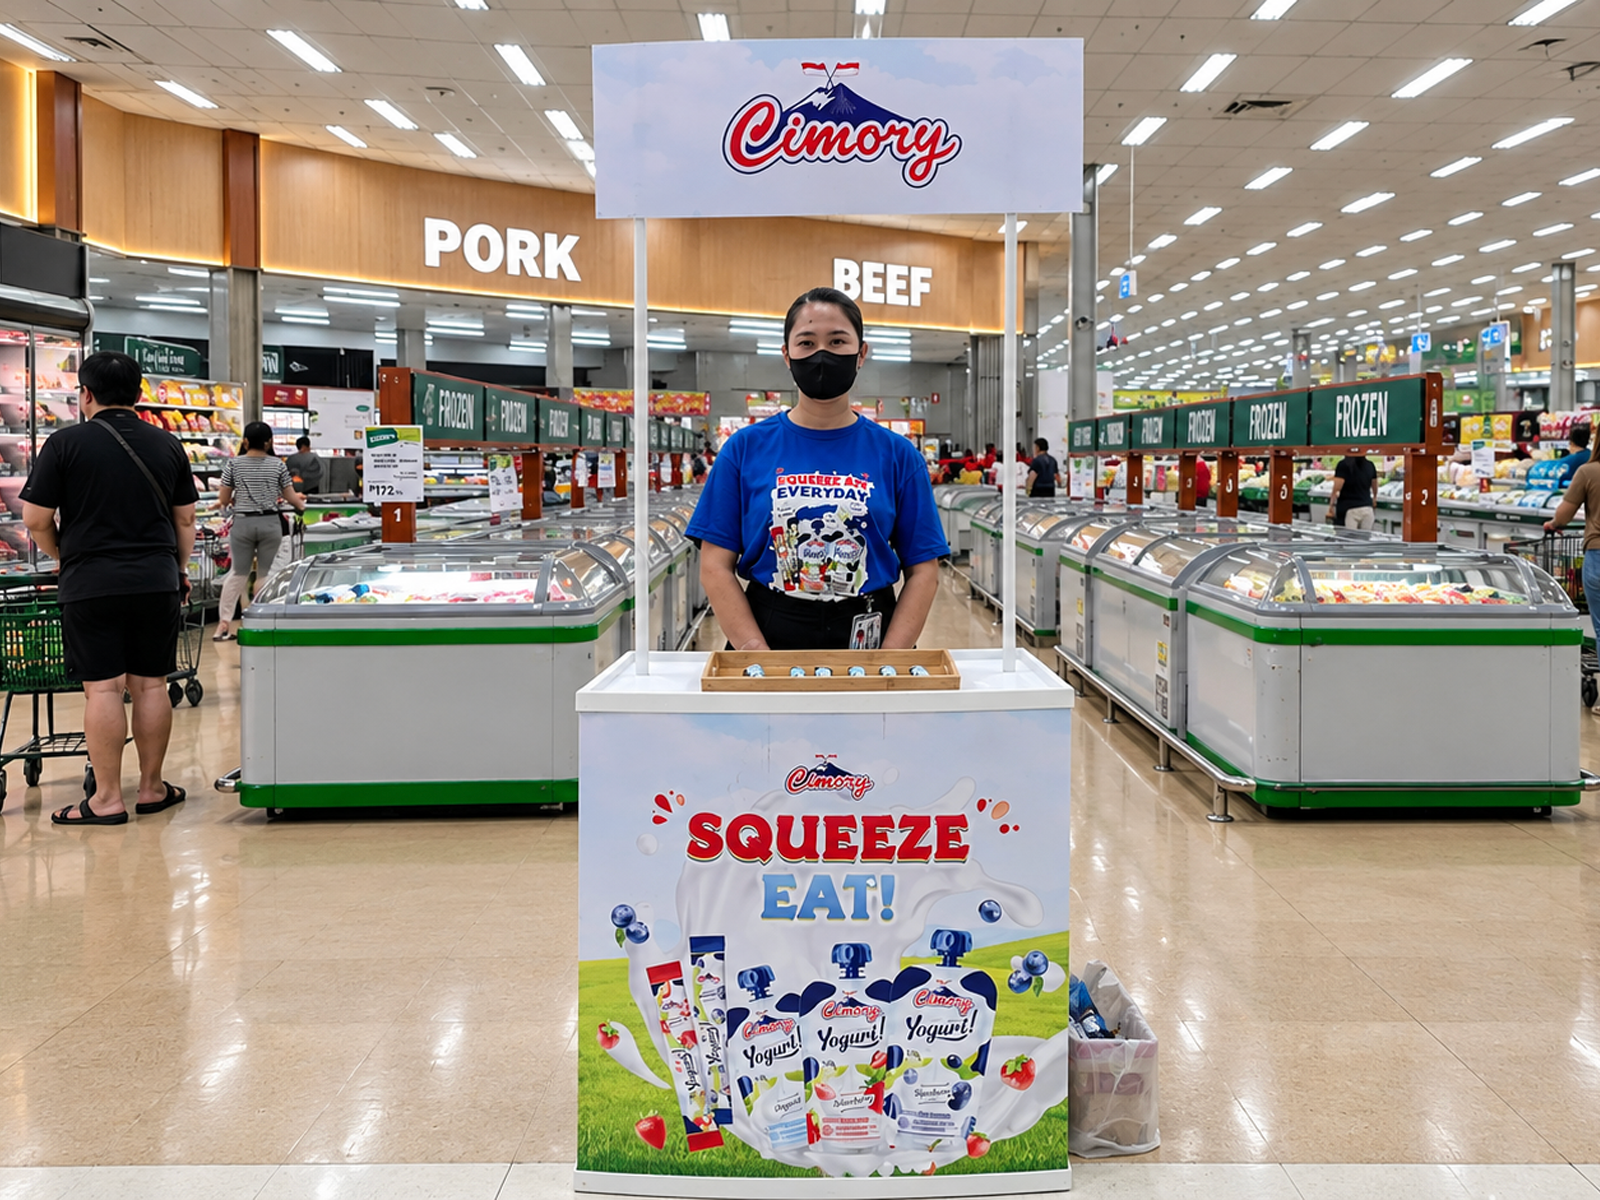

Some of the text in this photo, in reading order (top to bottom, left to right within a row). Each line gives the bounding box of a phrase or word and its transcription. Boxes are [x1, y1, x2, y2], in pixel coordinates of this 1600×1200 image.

[722, 93, 962, 188] Cimory
[424, 217, 581, 282] PORK
[833, 258, 933, 307] BEEF
[438, 389, 475, 430] FROZEN
[1249, 402, 1287, 441] FROZEN
[1335, 391, 1388, 438] FROZEN
[777, 486, 868, 502] EVERYDAY
[785, 765, 875, 801] Cimory
[687, 812, 970, 865] SQUEEZE
[760, 874, 896, 921] EAT!
[817, 1016, 886, 1053] Yogurt!
[906, 1009, 979, 1044] Yogurt!
